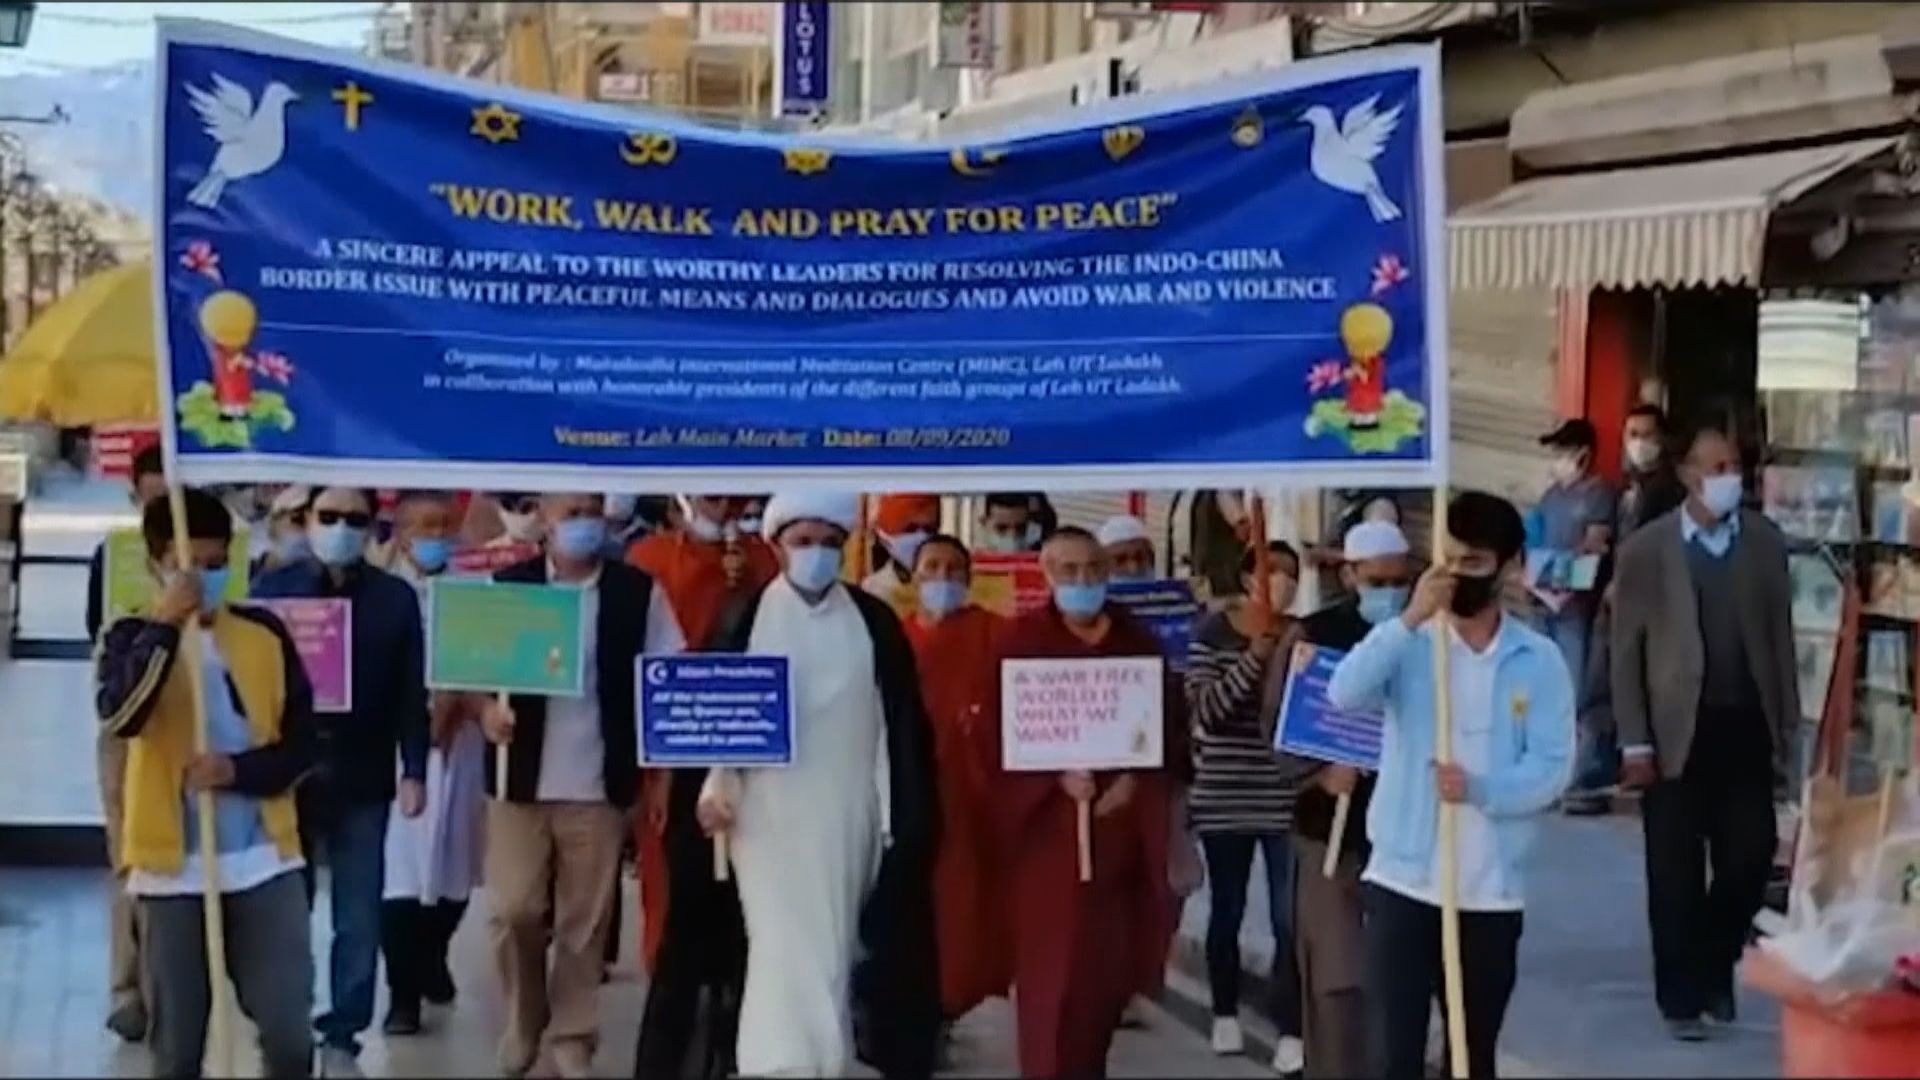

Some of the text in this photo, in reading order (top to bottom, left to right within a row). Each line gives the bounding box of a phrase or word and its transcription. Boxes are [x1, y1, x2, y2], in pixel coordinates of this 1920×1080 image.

[594, 199, 713, 235] WALK
[732, 208, 820, 238] AND
[830, 208, 934, 237] PRAY
[946, 206, 1025, 233] FOR
[315, 237, 1283, 283] A SINCERE APPEAL TO THE WORTHY LEADERS FOR RESOLVING THE INDO-CHINA
[260, 266, 1337, 312] BORDER ISSUE WITH PEACEFUL MEANS AND DIALOGUES AND AVOID WAR AND VIOLENCE
[554, 426, 632, 447] Venue:
[634, 426, 673, 447] Leh
[676, 427, 730, 447] Main
[732, 428, 807, 448] Market
[823, 428, 882, 448] Date:
